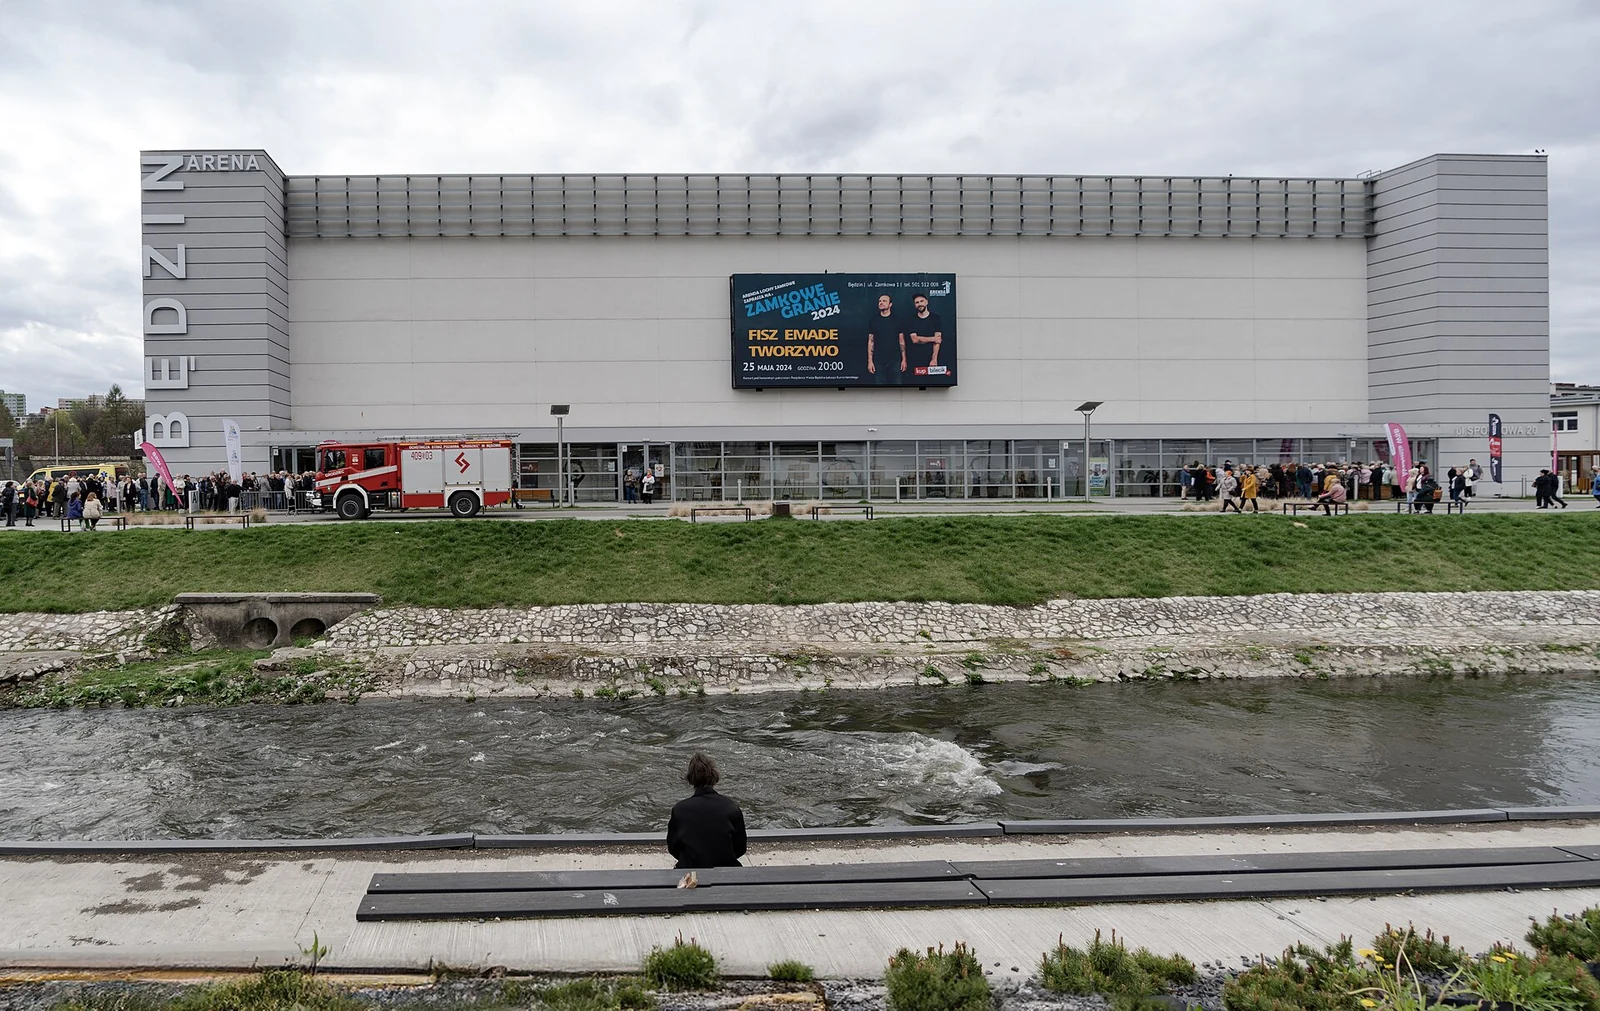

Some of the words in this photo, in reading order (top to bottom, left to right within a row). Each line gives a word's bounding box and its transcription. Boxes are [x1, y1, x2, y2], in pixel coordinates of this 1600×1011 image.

[187, 155, 260, 170] ARENA
[141, 155, 196, 447] BĘDZIN
[744, 283, 826, 317] ZAMKOWE
[781, 292, 841, 319] GRANIE
[811, 305, 841, 321] 2024
[748, 329, 779, 341] FISZ
[784, 329, 839, 341] EMADE
[748, 345, 839, 357] TWORZYWO
[742, 362, 755, 371] 25
[817, 361, 844, 371] 20:00
[1526, 425, 1538, 435] 20
